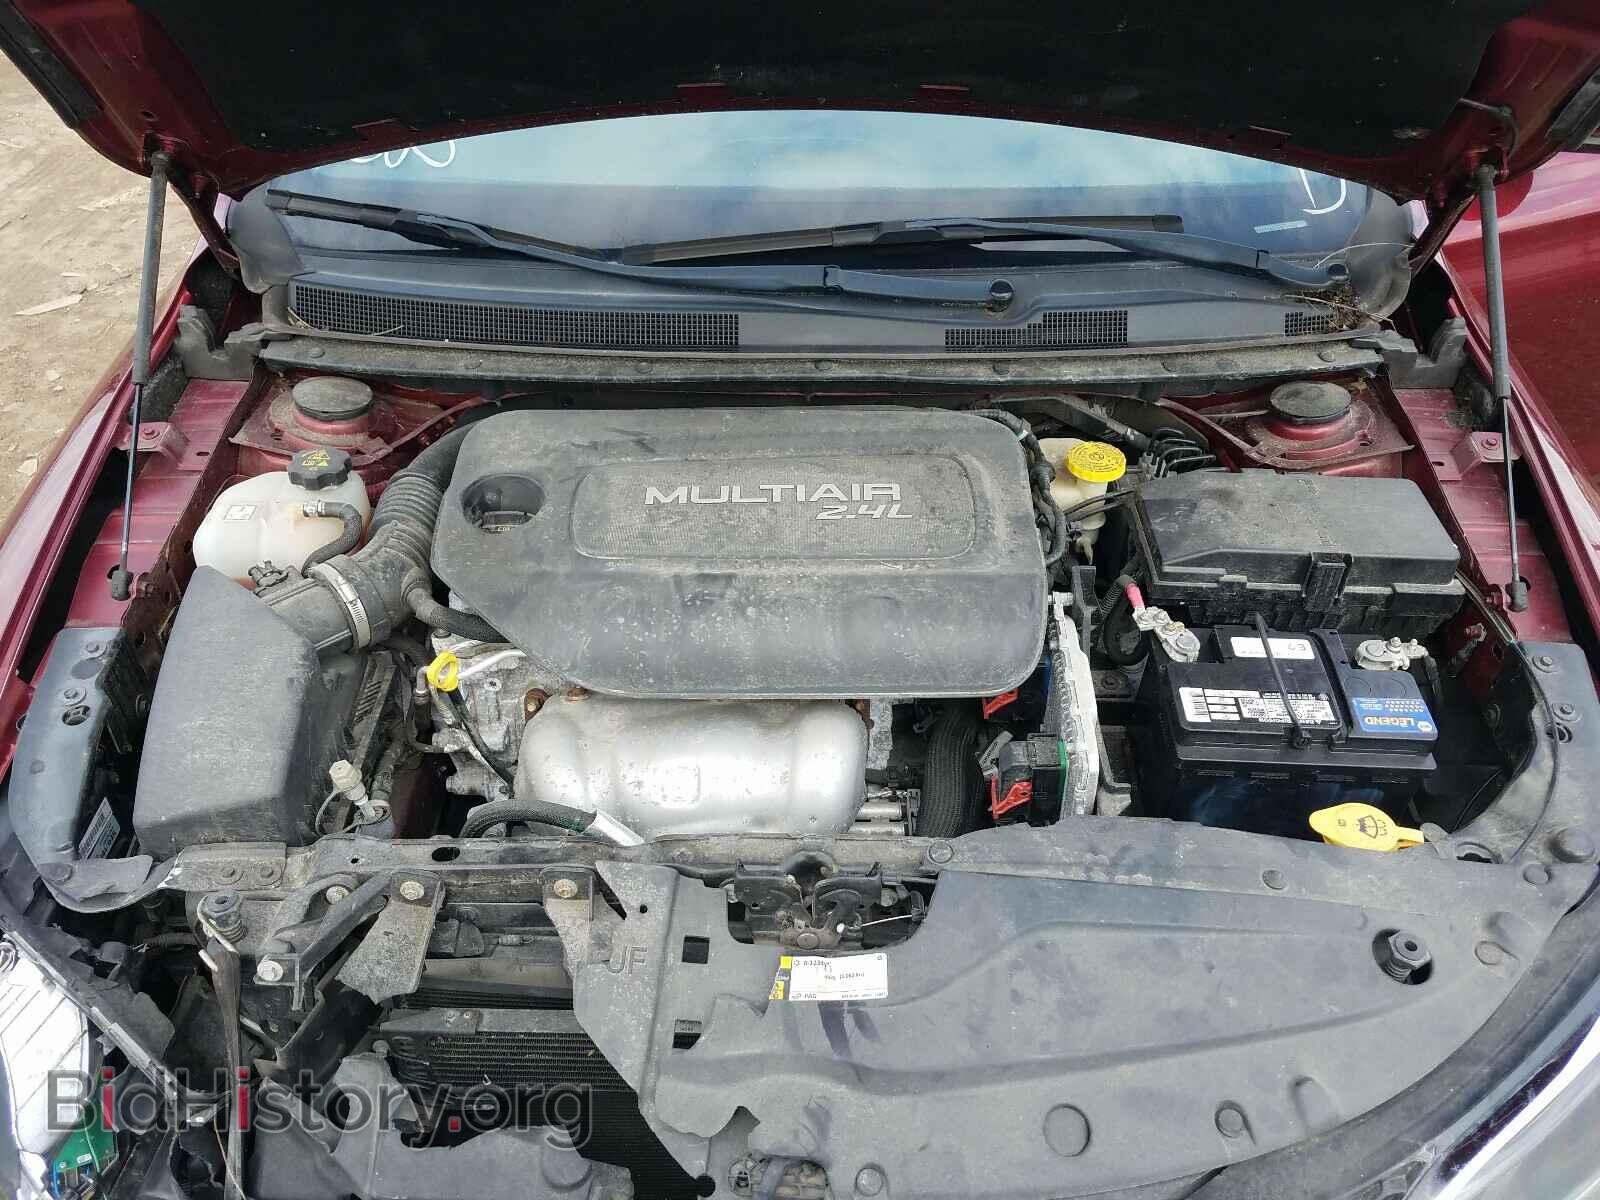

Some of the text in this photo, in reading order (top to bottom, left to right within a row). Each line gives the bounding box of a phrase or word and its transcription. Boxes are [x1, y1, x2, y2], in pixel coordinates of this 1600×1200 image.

[645, 483, 902, 505] MULTIAIR
[815, 504, 913, 520] 2.4L
[1364, 716, 1415, 727] LEGEND
[608, 943, 649, 974] JF
